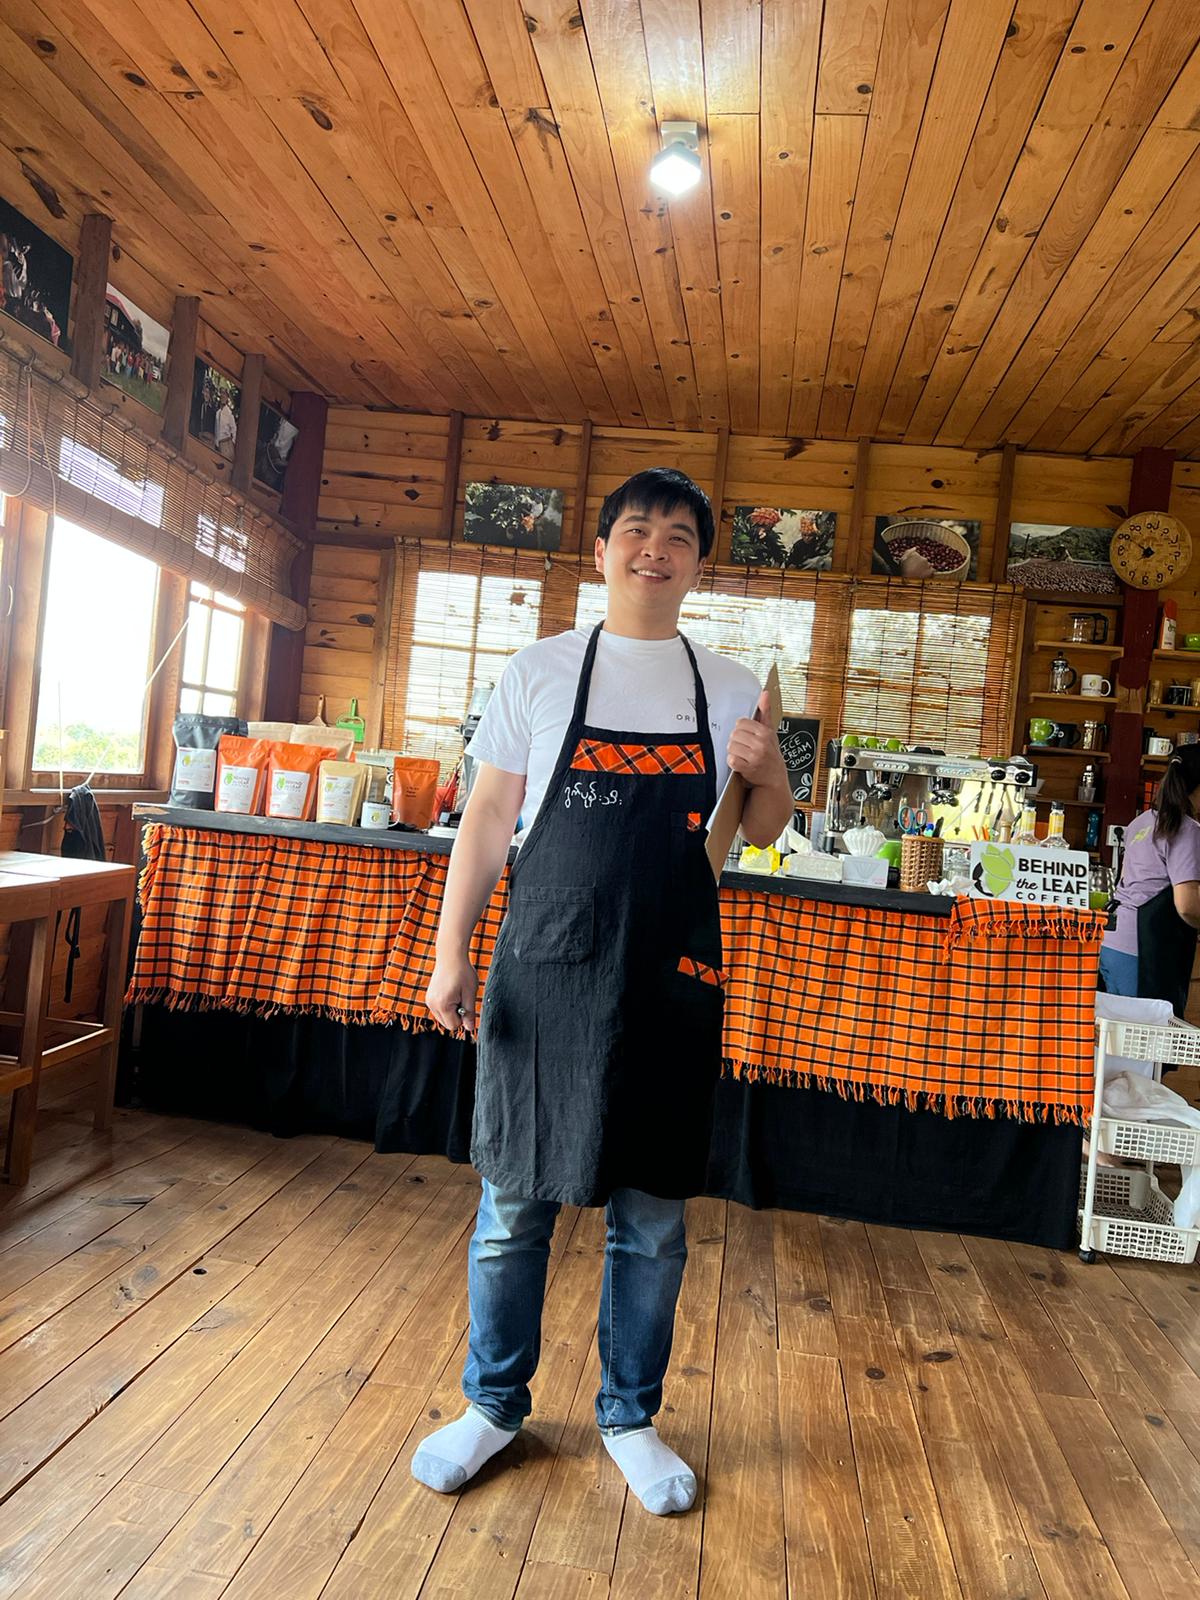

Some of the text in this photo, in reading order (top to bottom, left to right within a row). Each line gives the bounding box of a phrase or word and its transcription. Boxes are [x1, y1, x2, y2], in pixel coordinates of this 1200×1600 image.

[676, 713, 721, 731] ORIMI
[781, 736, 801, 753] ICE
[783, 741, 812, 762] CREAM
[789, 753, 812, 768] 3000
[1018, 858, 1088, 878] BEHIND
[1016, 877, 1088, 895] the LEAF
[1016, 891, 1087, 907] COFFEE
